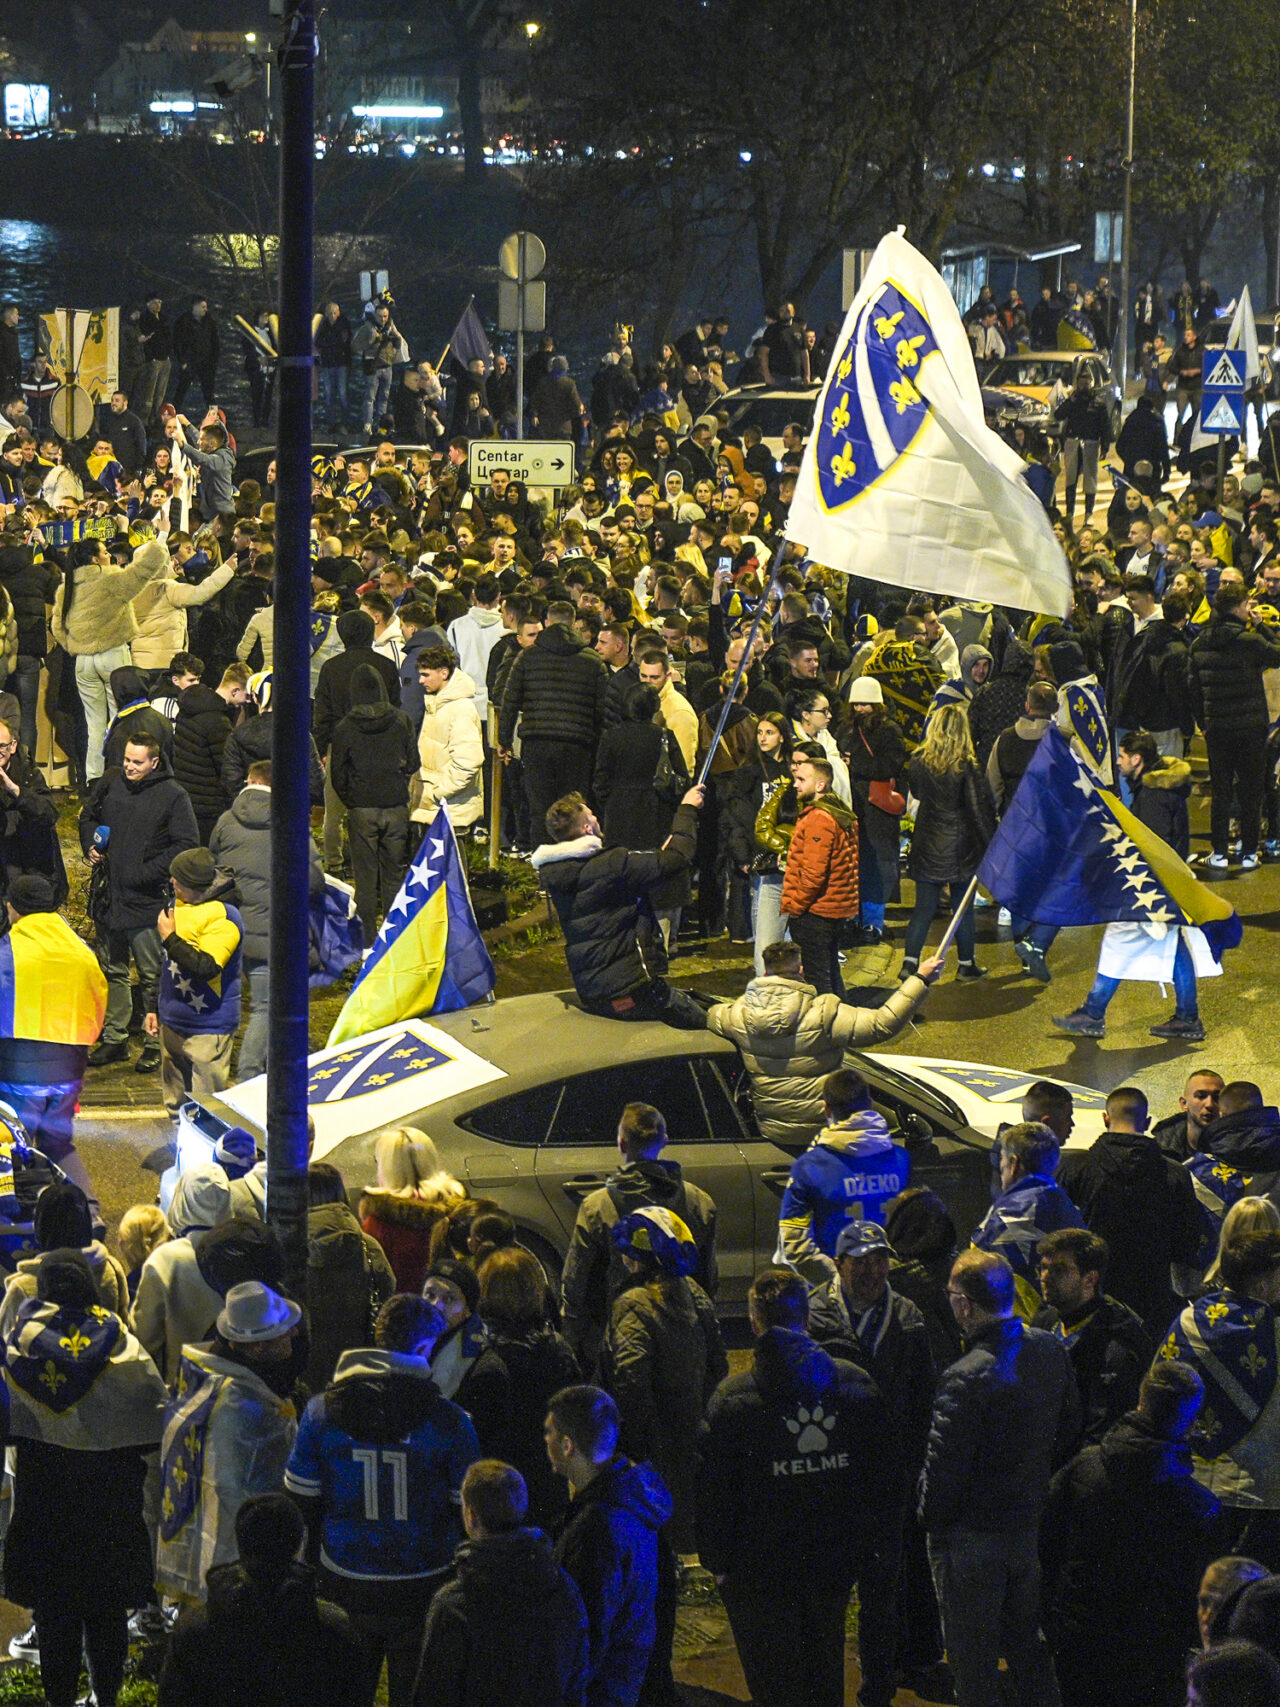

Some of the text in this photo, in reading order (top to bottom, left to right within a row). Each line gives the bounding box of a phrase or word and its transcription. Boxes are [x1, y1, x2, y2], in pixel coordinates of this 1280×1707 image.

[477, 449, 524, 462] Centar
[477, 465, 529, 481] Цар
[842, 1171, 900, 1197] DŽEKO
[772, 1452, 850, 1477] KELME
[352, 1448, 408, 1521] 11
